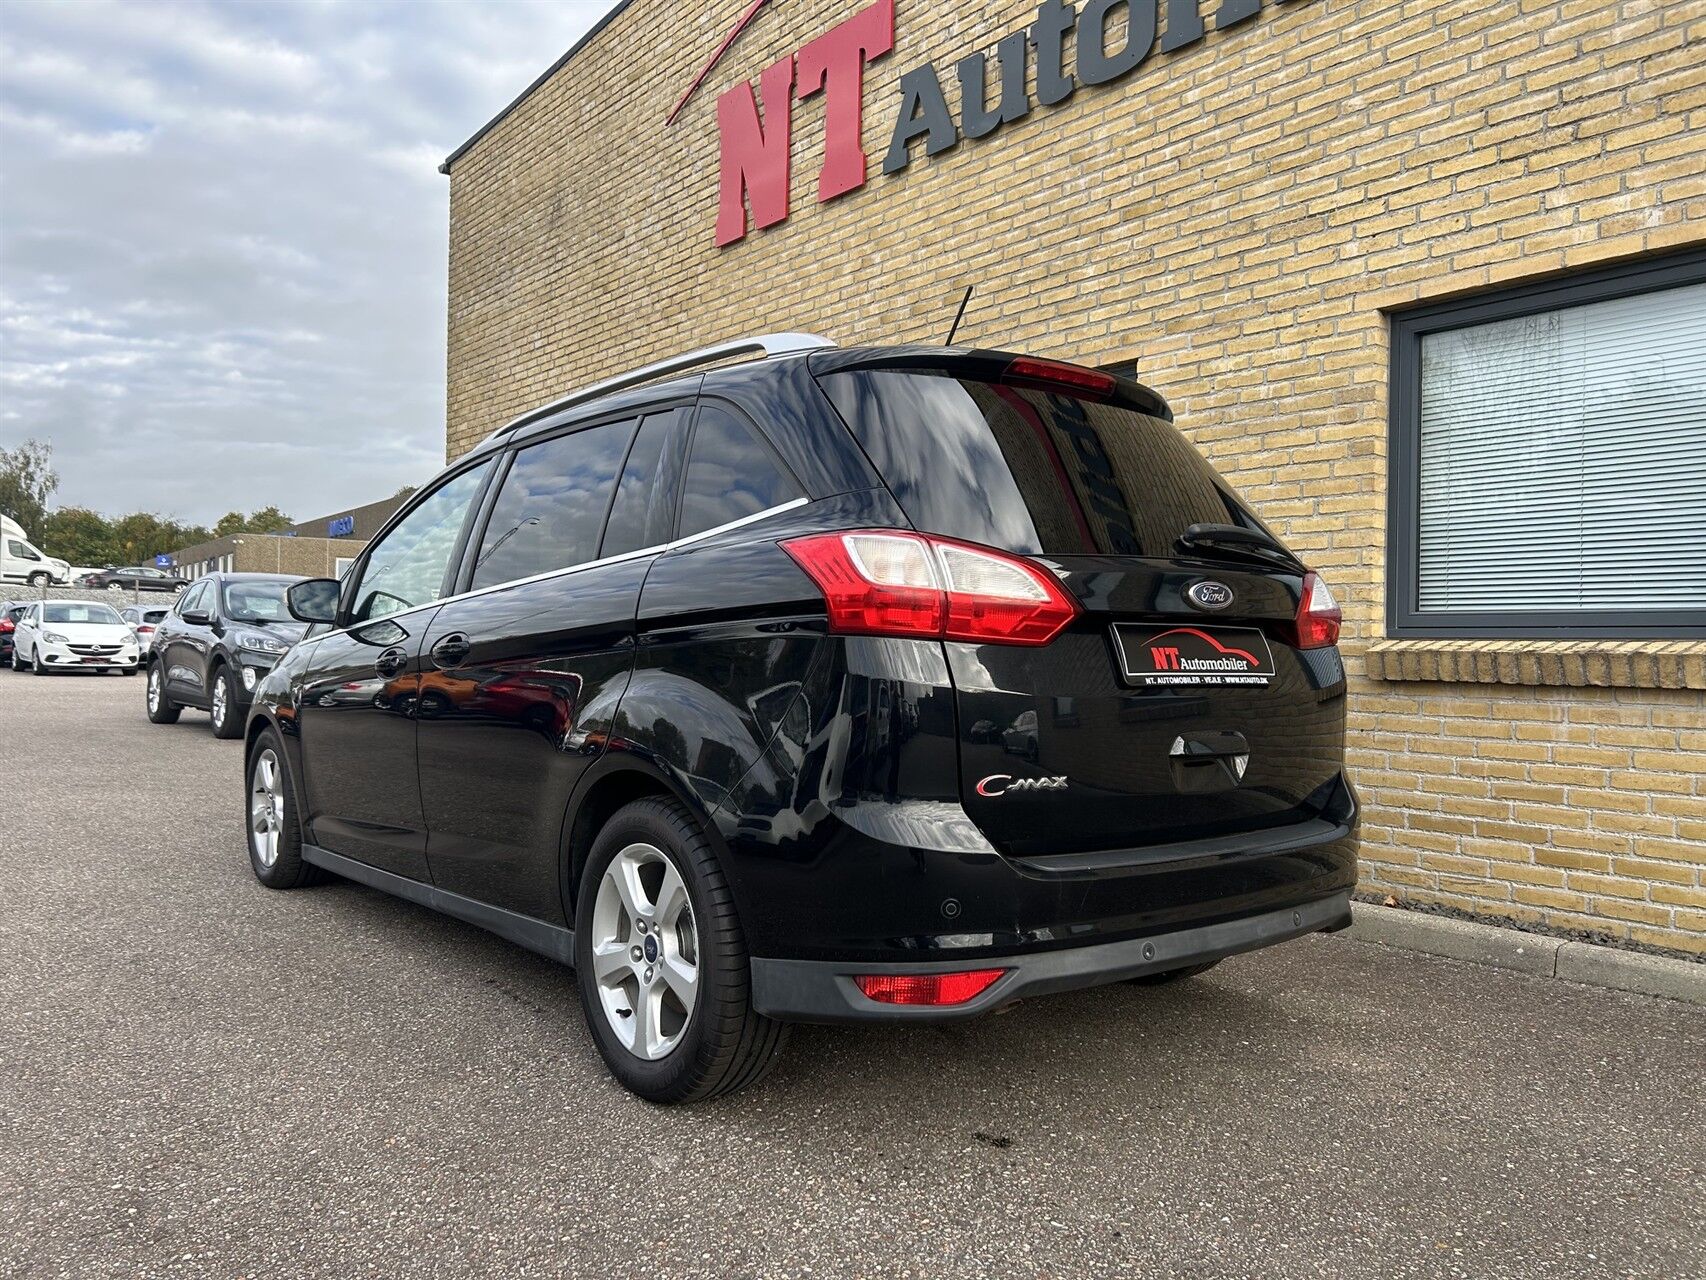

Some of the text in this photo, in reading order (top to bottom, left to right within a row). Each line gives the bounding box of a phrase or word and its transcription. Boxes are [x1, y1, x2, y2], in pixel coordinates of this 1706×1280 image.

[715, 0, 1290, 248] NT Auto
[1201, 585, 1226, 602] Ford
[1150, 647, 1248, 671] NT Automobiler
[1157, 676, 1201, 685] AUTOMOBILER
